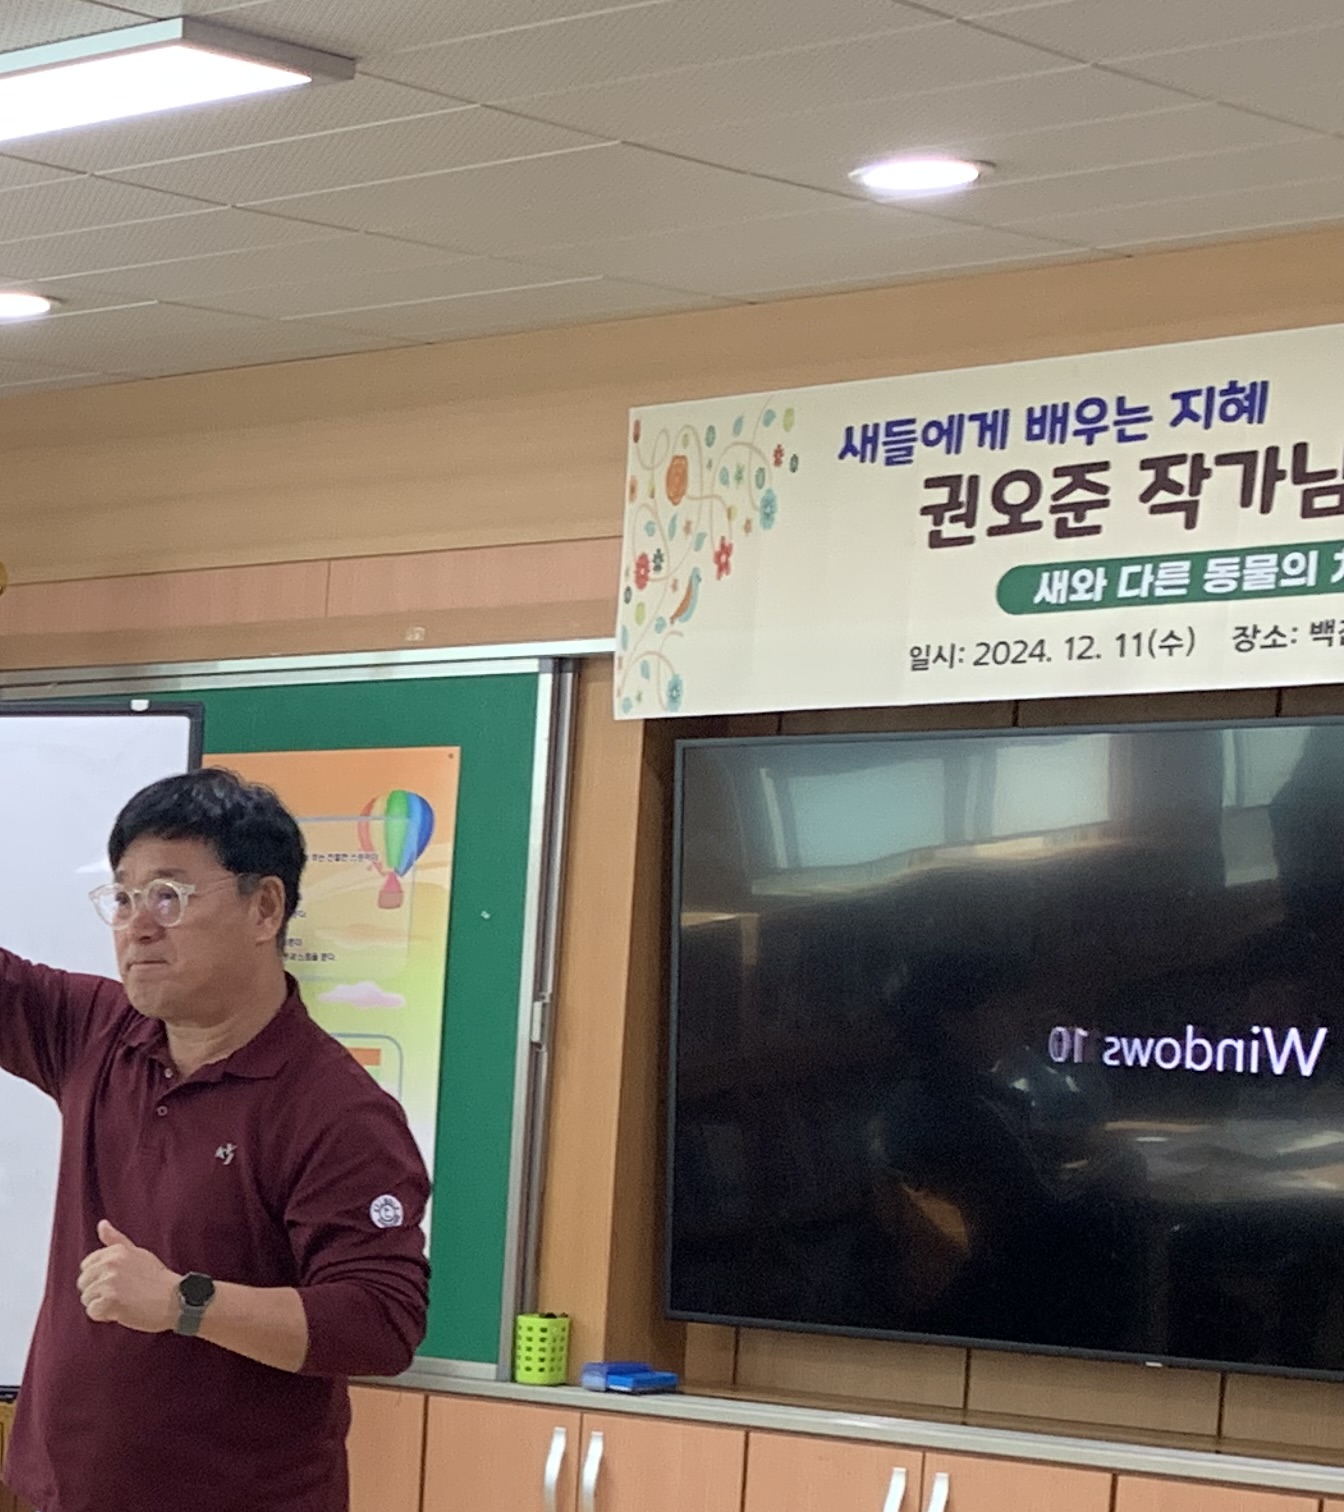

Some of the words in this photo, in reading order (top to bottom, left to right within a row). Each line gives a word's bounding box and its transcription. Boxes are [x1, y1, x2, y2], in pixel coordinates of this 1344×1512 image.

[837, 407, 1010, 467] 새들에게
[1024, 395, 1154, 446] 배우는
[1169, 379, 1271, 430] 지혜
[918, 460, 1112, 549] 권오준
[1032, 566, 1108, 605] 새와
[1116, 559, 1192, 600] 다른
[1203, 549, 1320, 594] 동물의
[909, 643, 966, 673] 일시:
[972, 638, 1054, 668] 2024.
[1064, 634, 1103, 662] 12.
[1114, 626, 1197, 660] 11(수)
[1231, 623, 1299, 653] 장소:
